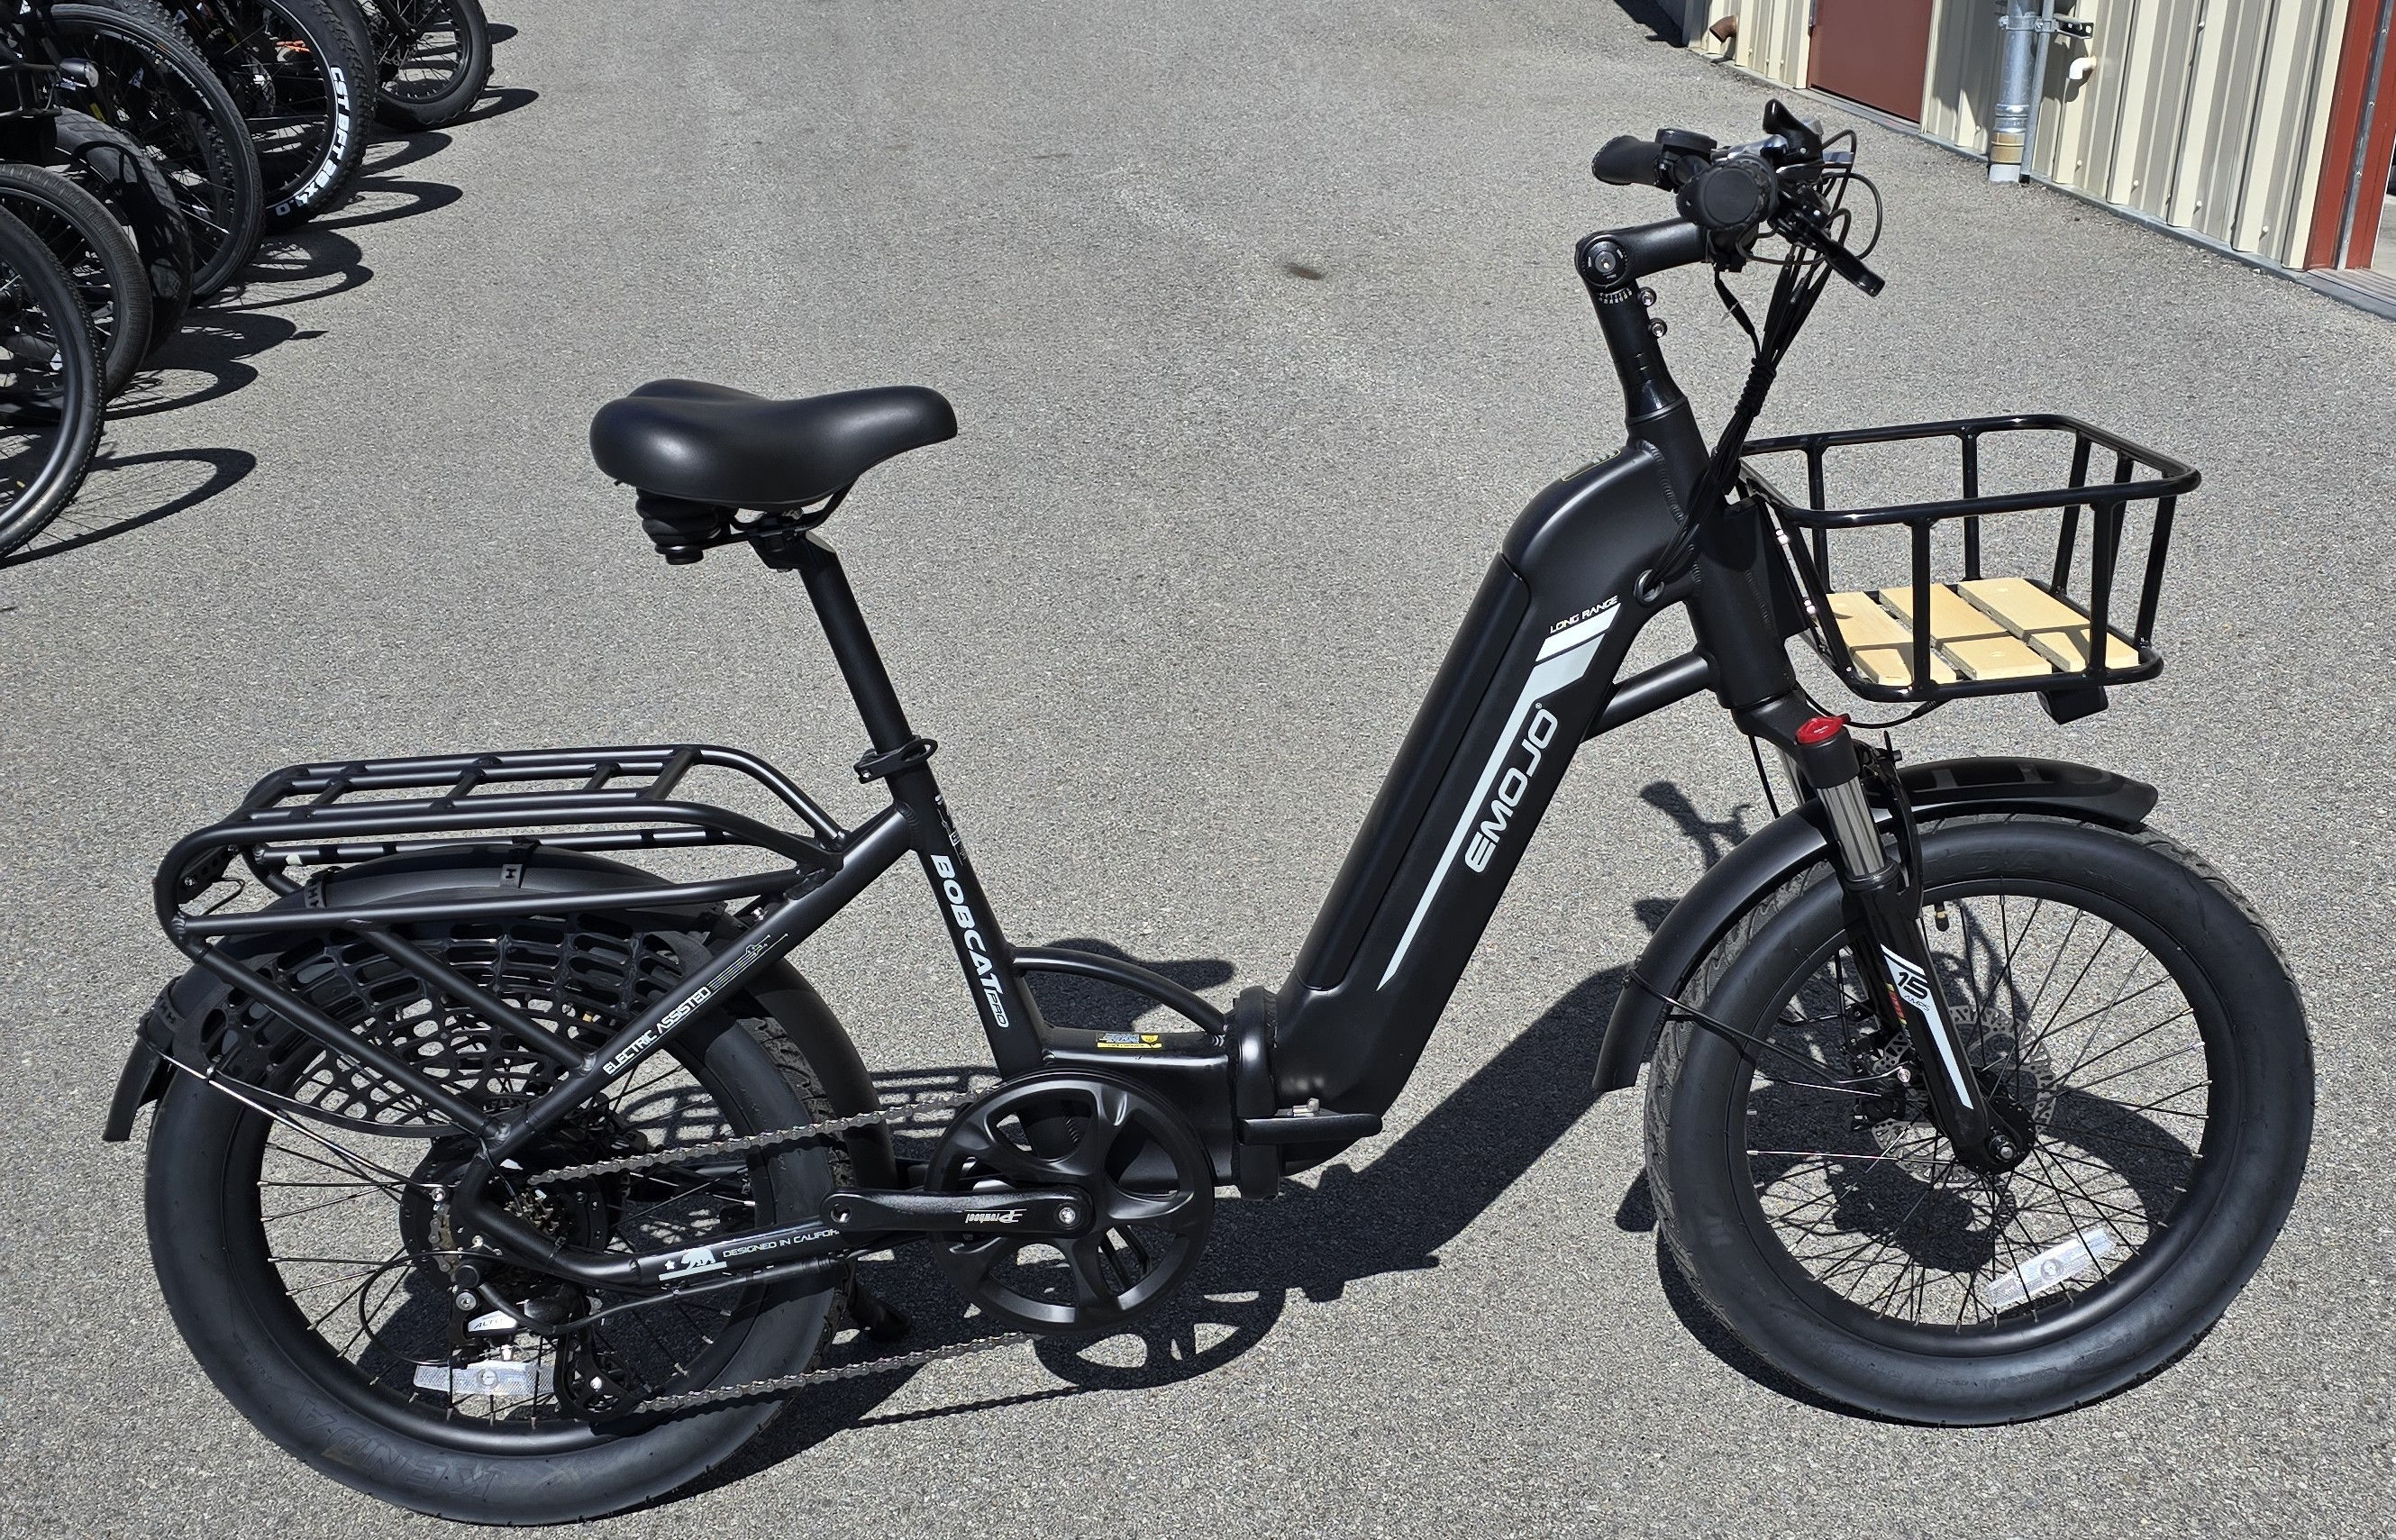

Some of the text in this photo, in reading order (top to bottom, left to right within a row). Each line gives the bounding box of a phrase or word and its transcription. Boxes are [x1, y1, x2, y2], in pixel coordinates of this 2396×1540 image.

[330, 67, 351, 111] CST
[1550, 595, 1618, 634] LONG RANGE
[1464, 708, 1559, 873] EMOJO
[930, 854, 1004, 995] BOBCAT
[1897, 971, 1929, 1000] 15
[1903, 995, 1931, 1012] AMPS
[602, 986, 712, 1075] ELECTRIC ASSISTED
[723, 1242, 778, 1258] DESIGNED
[779, 1237, 792, 1247] IN
